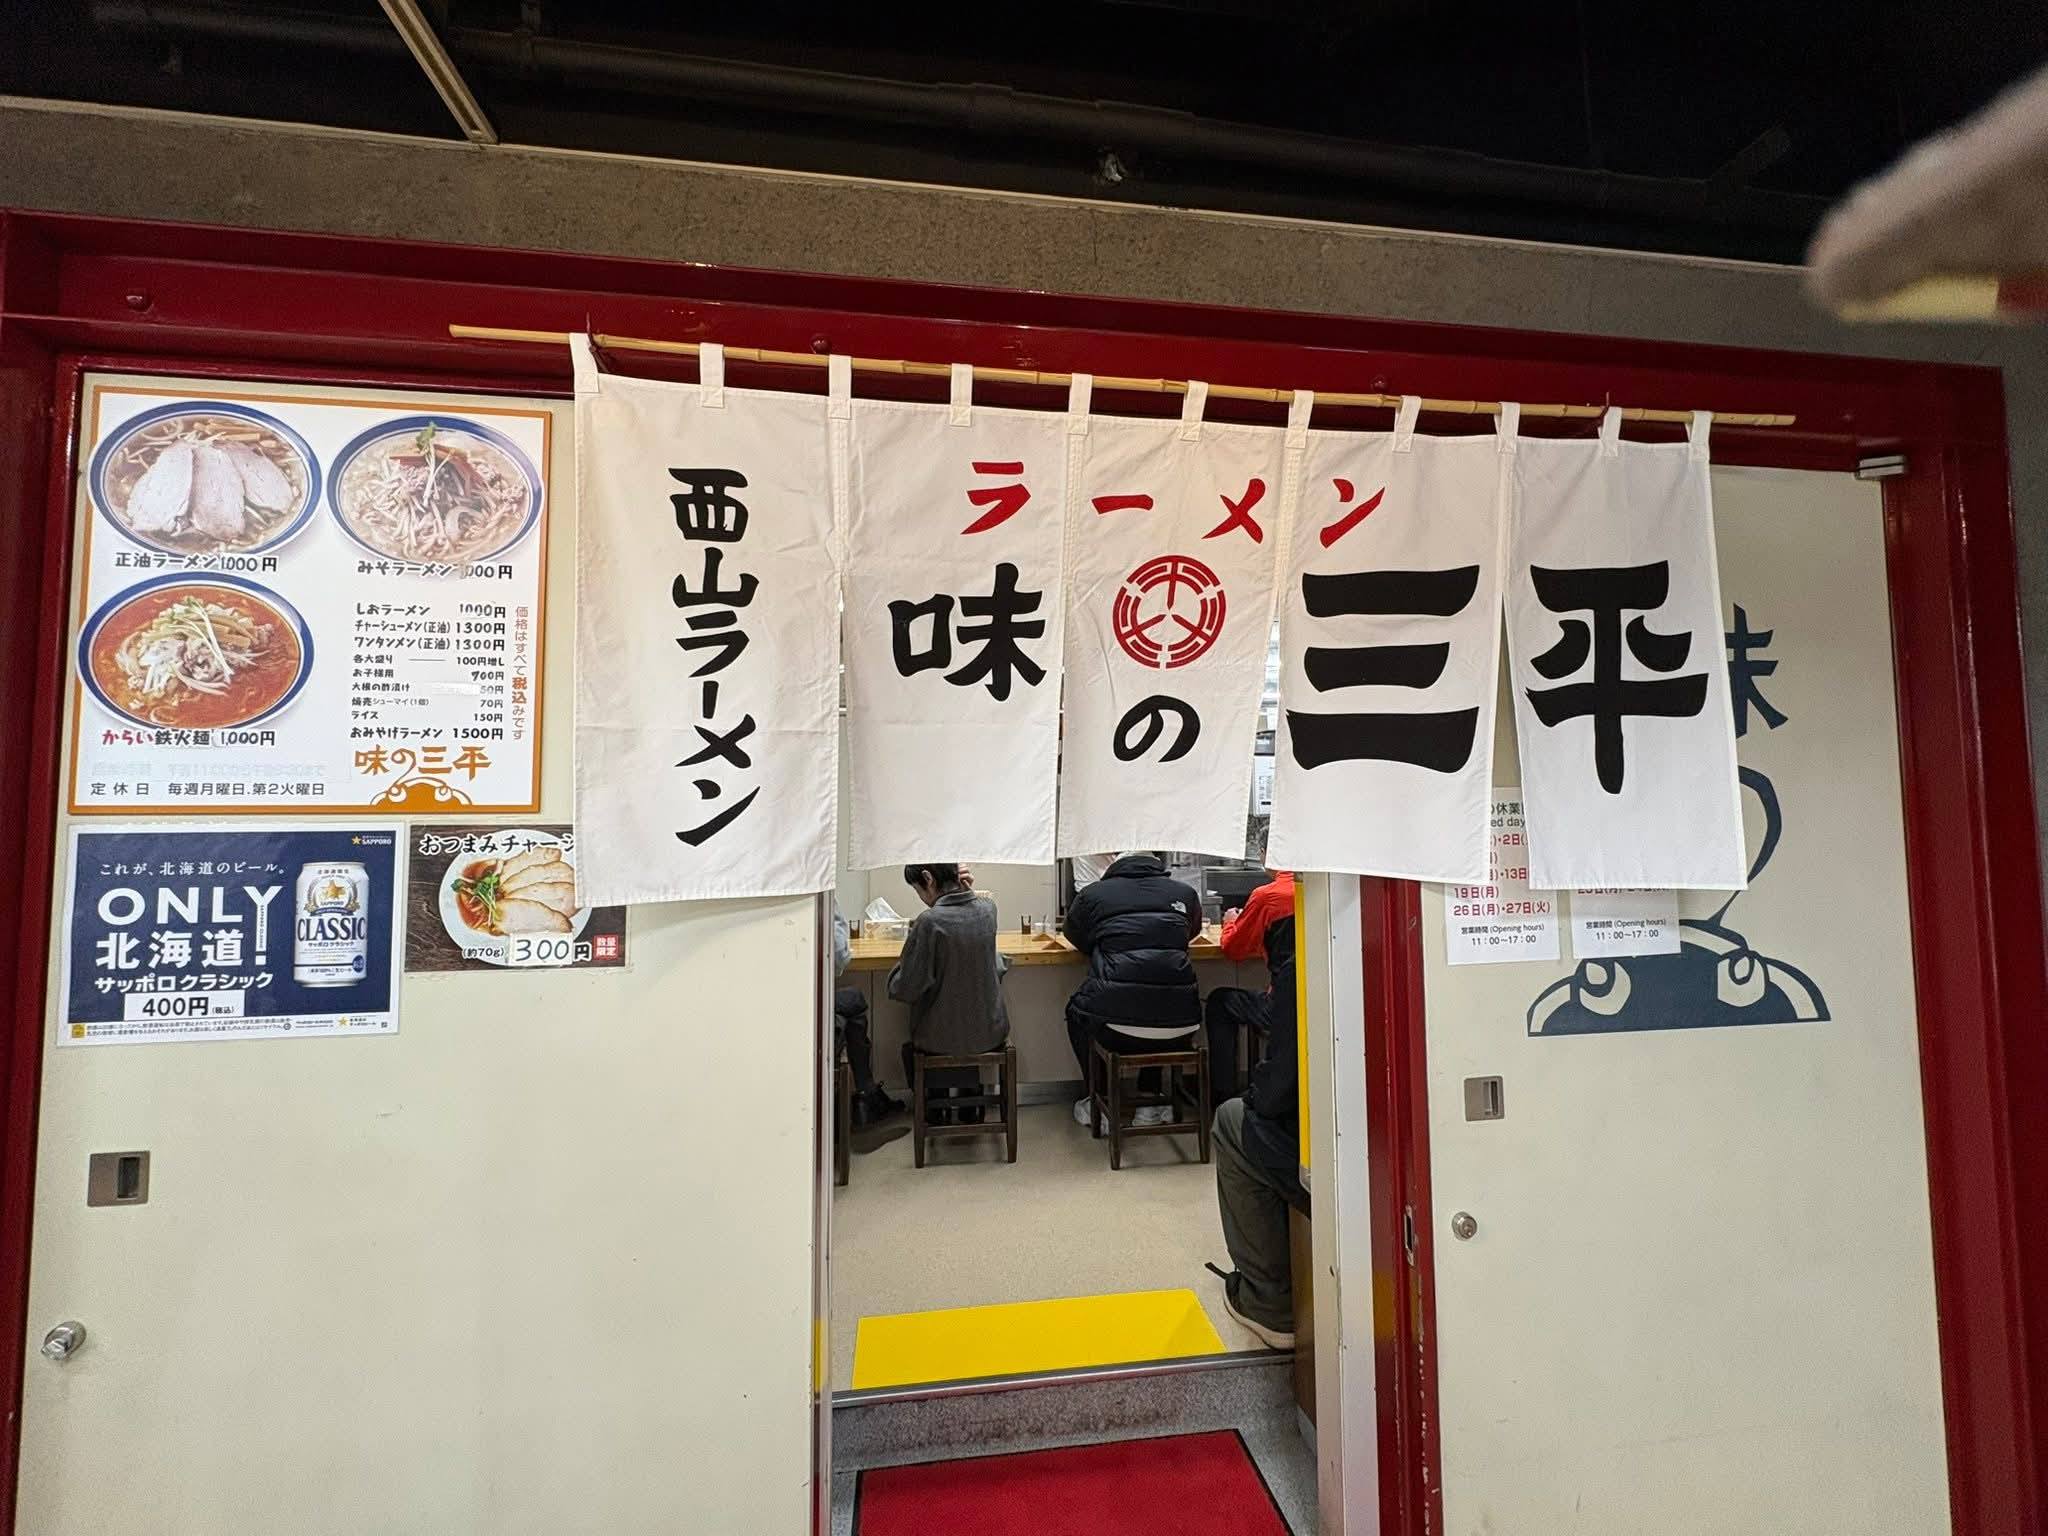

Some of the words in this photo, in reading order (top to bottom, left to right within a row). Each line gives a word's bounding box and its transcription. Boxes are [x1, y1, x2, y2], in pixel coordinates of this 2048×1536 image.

[960, 461, 1385, 548] ラーメン
[115, 552, 217, 569] 正油ラーメン
[357, 560, 452, 576] みそラーメン
[357, 603, 431, 616] しおラーメン
[459, 603, 506, 618] 1000円
[456, 622, 505, 635] 1300円
[455, 639, 505, 651] 1300円
[353, 654, 393, 664] 各大盛り
[457, 656, 505, 667] 100円増し
[668, 468, 760, 846] 西山ラーメン
[352, 668, 394, 678] お子様用
[471, 671, 504, 681] 700円
[512, 606, 529, 740] 価格はすべて税込みです
[887, 560, 1708, 794] 味の三平
[480, 699, 503, 708] 70円
[352, 711, 379, 720] ライス
[474, 713, 503, 722] 150円
[102, 730, 210, 746] からい鉄火麺
[350, 727, 443, 739] おみやげラーメン
[453, 728, 503, 740] 1500円
[354, 744, 492, 780] 味の三平
[91, 782, 150, 796] 定休日
[100, 861, 286, 876] これが、北海道のビール。
[1454, 886, 1499, 899] 19日(月)
[98, 885, 283, 938] ONLY
[297, 917, 366, 941] CLASSIC
[143, 997, 209, 1016] 400円
